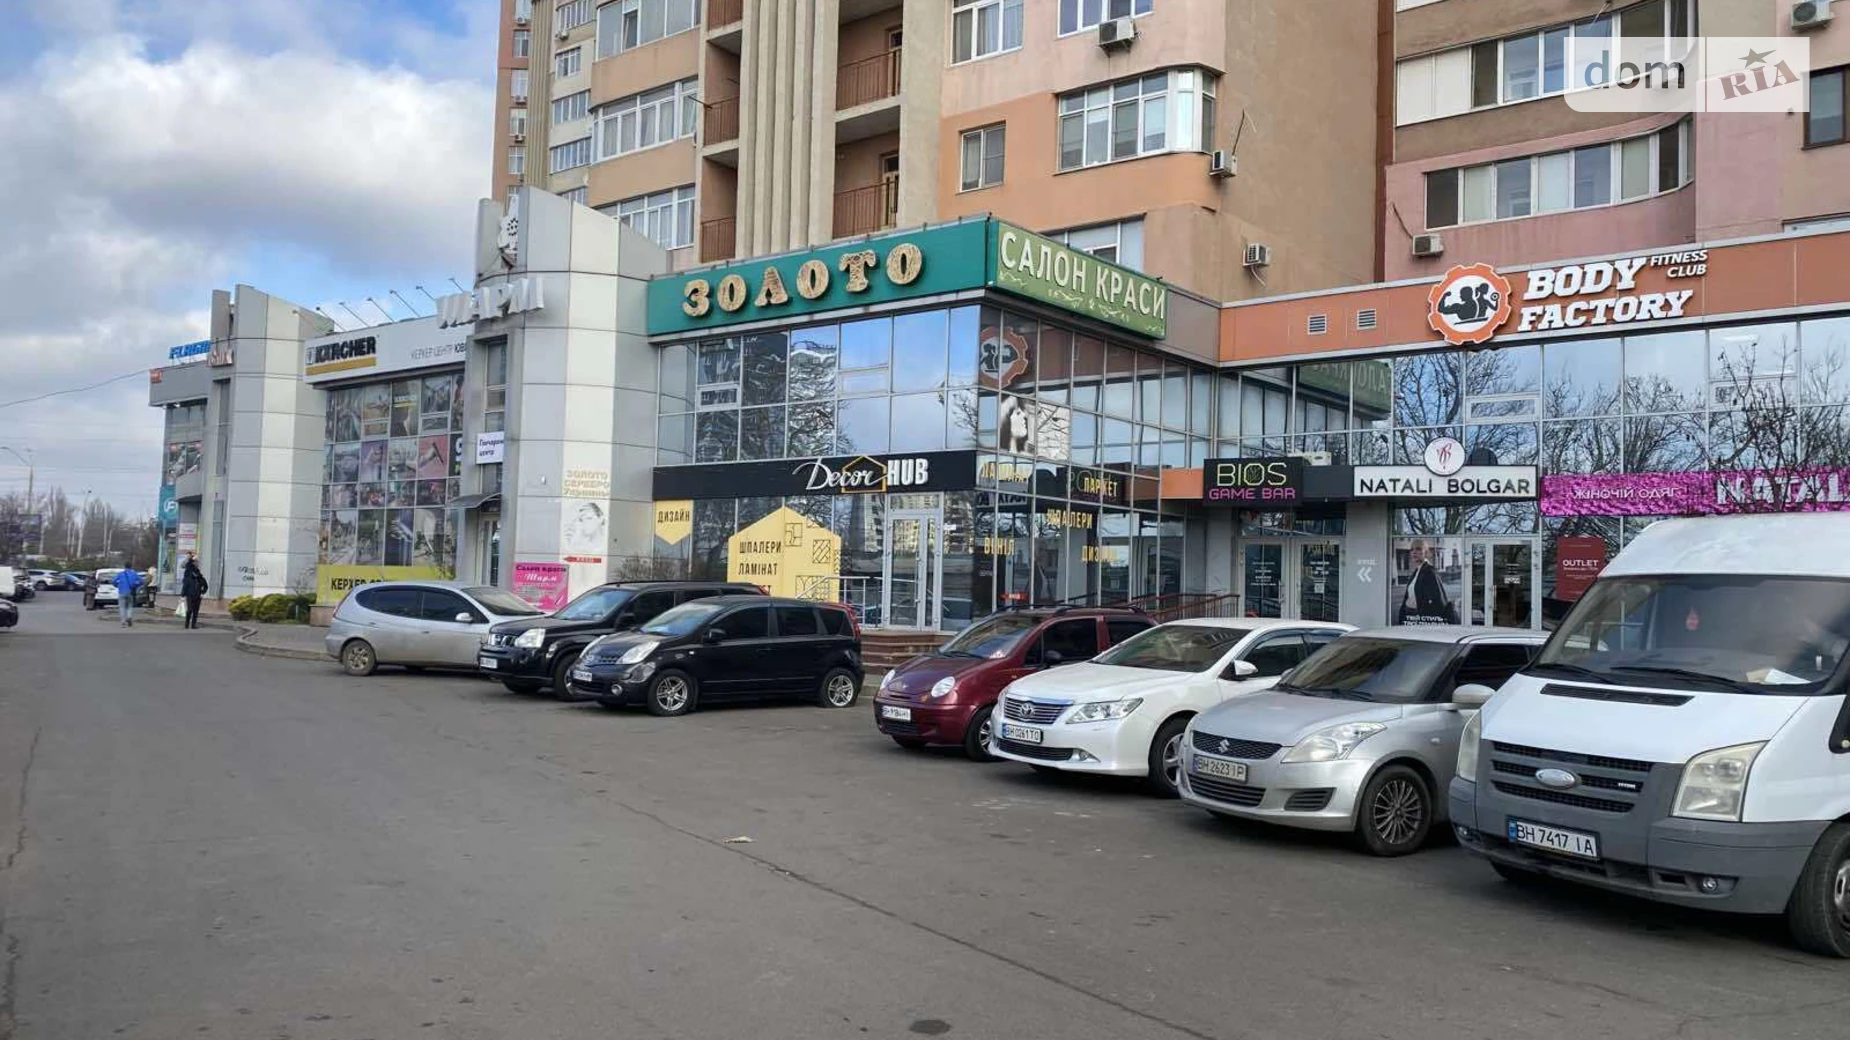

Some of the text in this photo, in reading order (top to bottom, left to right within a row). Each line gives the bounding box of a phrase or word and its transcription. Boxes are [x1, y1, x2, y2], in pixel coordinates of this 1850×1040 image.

[682, 242, 922, 317] ЗОЛОТО
[1000, 231, 1166, 319] САЛОН КРАСИ
[1523, 250, 1708, 301] BODY FITNESS
[1667, 264, 1707, 279] CLUB
[1517, 289, 1694, 333] FACTORY
[792, 456, 929, 490] Decor HUB
[1217, 462, 1287, 487] BIOS
[1083, 477, 1118, 497] ПАРКЕТ
[1209, 487, 1296, 500] GAME BAR
[1360, 478, 1530, 494] NATALI BOLGAR
[1573, 486, 1676, 500] ЖІНОЧІЙ ОДЯГ
[657, 510, 690, 523] ДИЗАЙН
[739, 541, 782, 554] ШПАЛЕРИ
[738, 562, 778, 576] ЛАМІНАТ
[1562, 559, 1599, 567] OUTLET
[1516, 824, 1594, 855] BH 7417 IA
